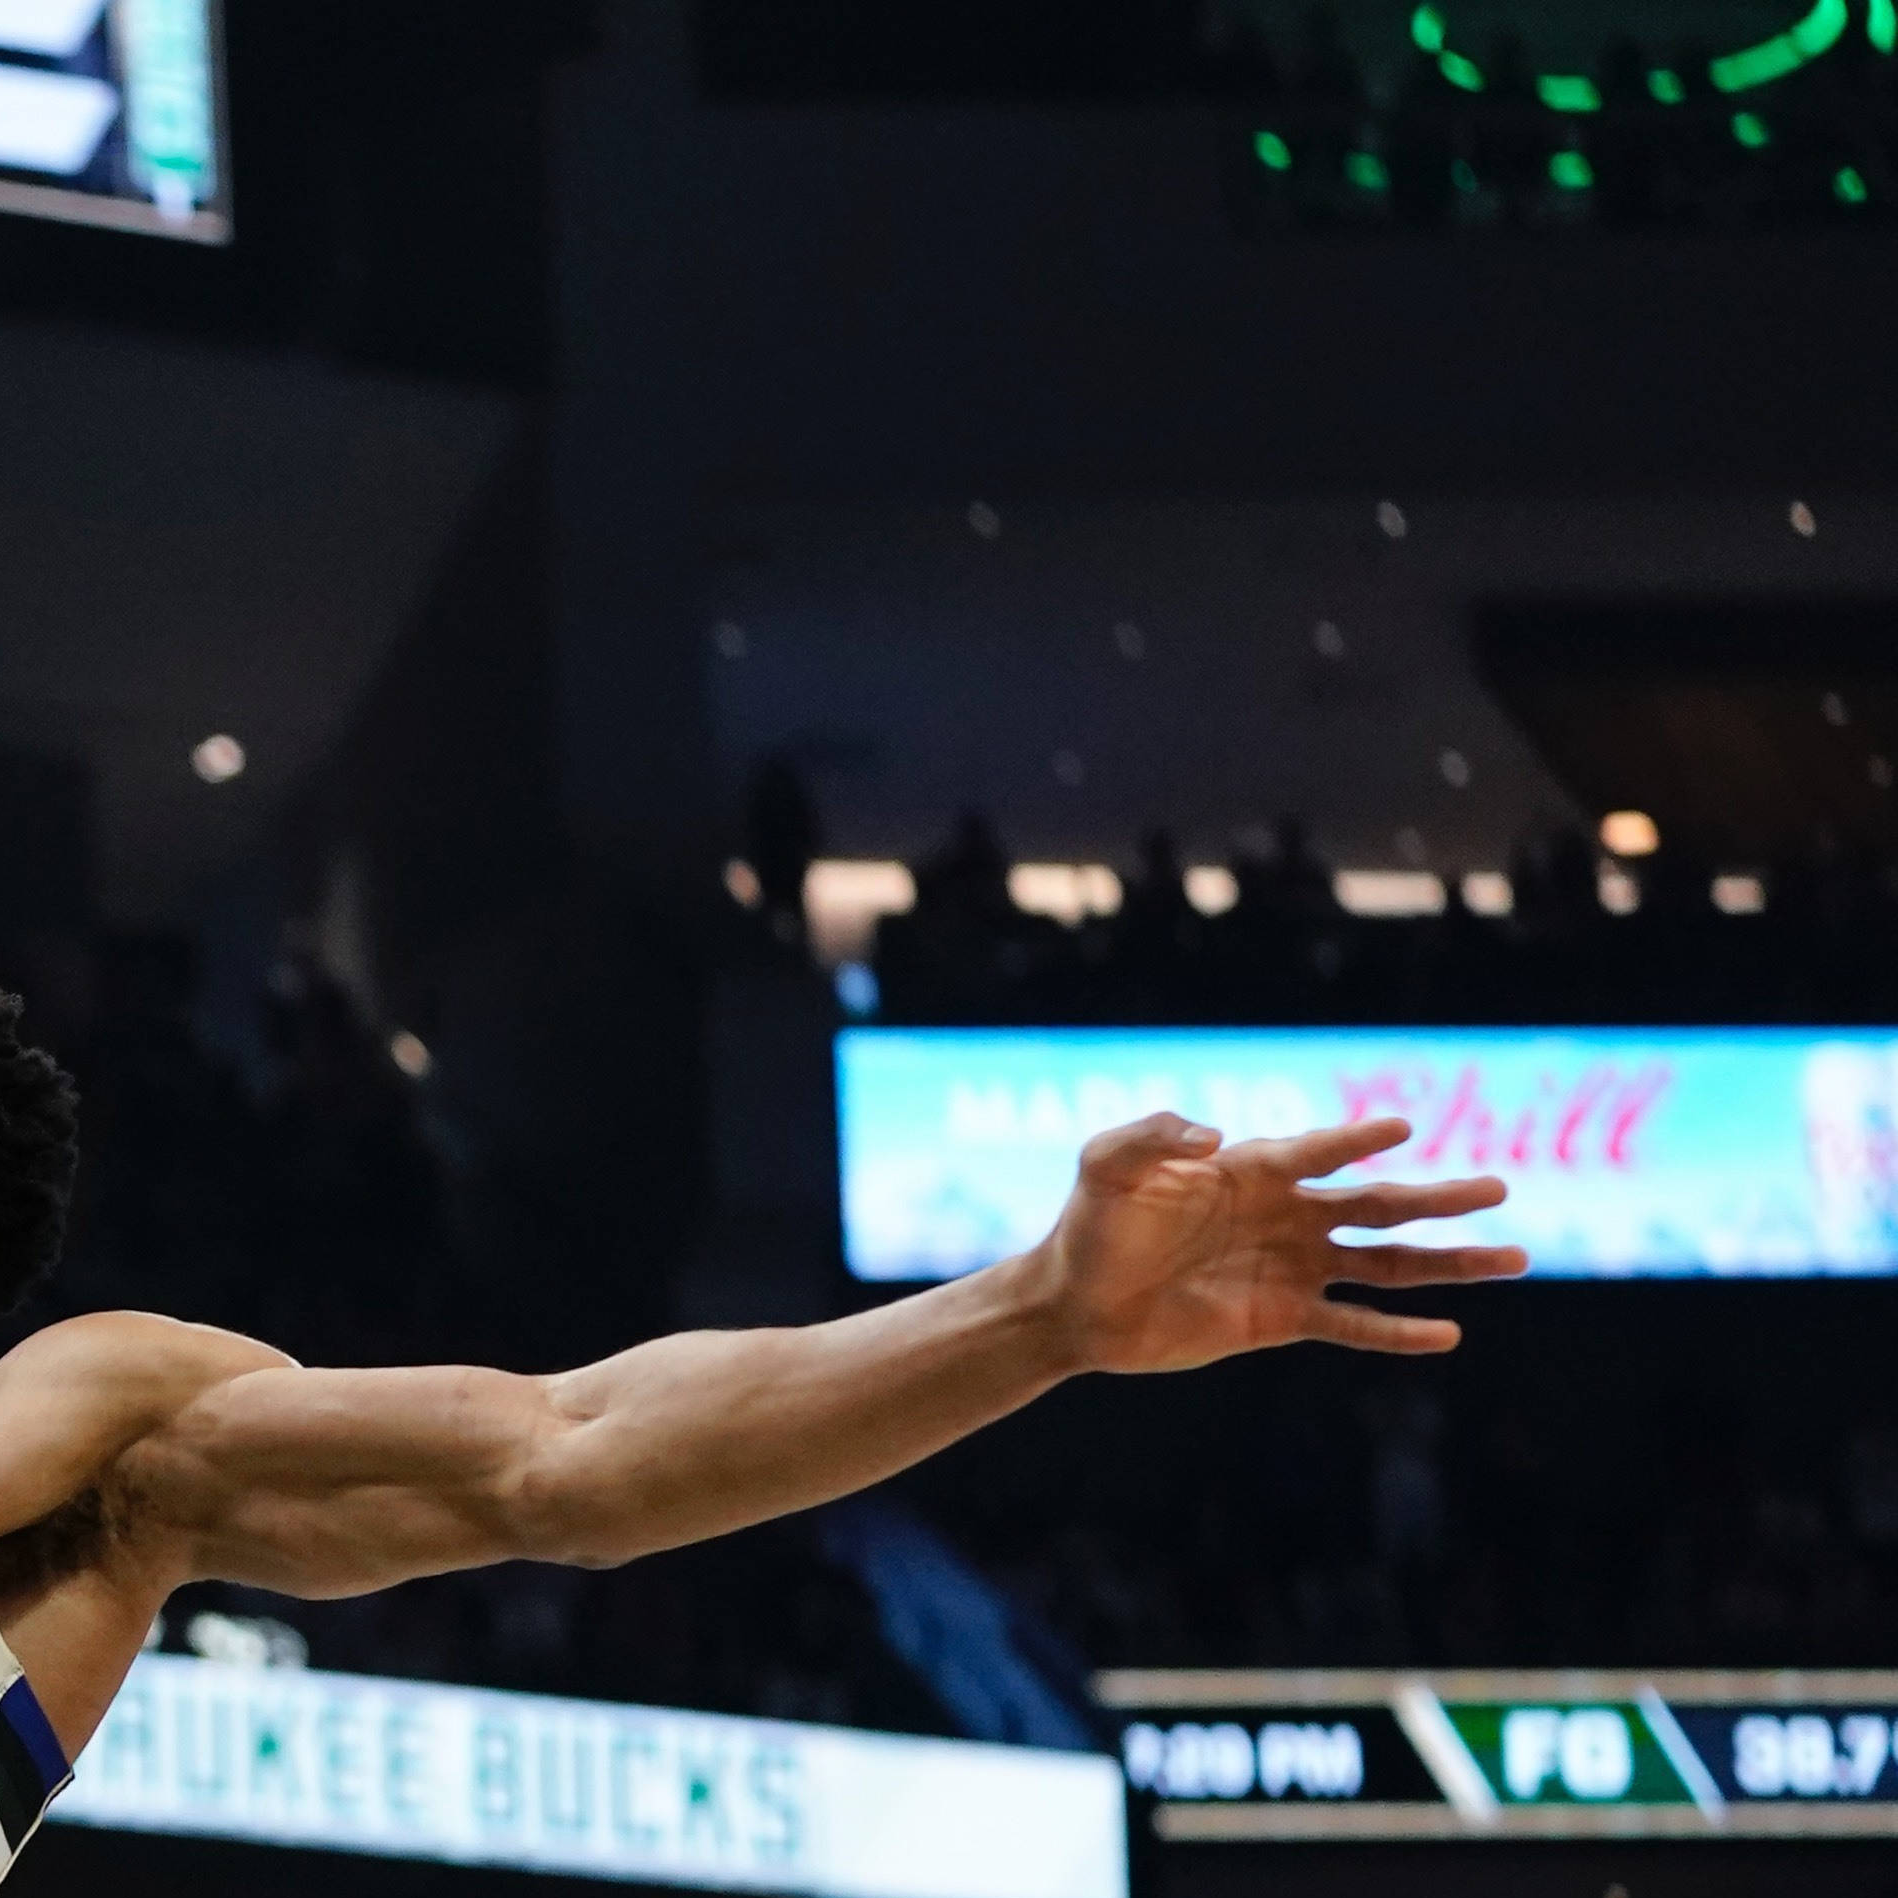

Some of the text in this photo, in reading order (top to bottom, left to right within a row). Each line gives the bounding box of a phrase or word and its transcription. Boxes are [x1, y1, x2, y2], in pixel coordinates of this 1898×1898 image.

[100, 1690, 807, 1861] AUKEE BUCKS
[1502, 1707, 1634, 1799] FG
